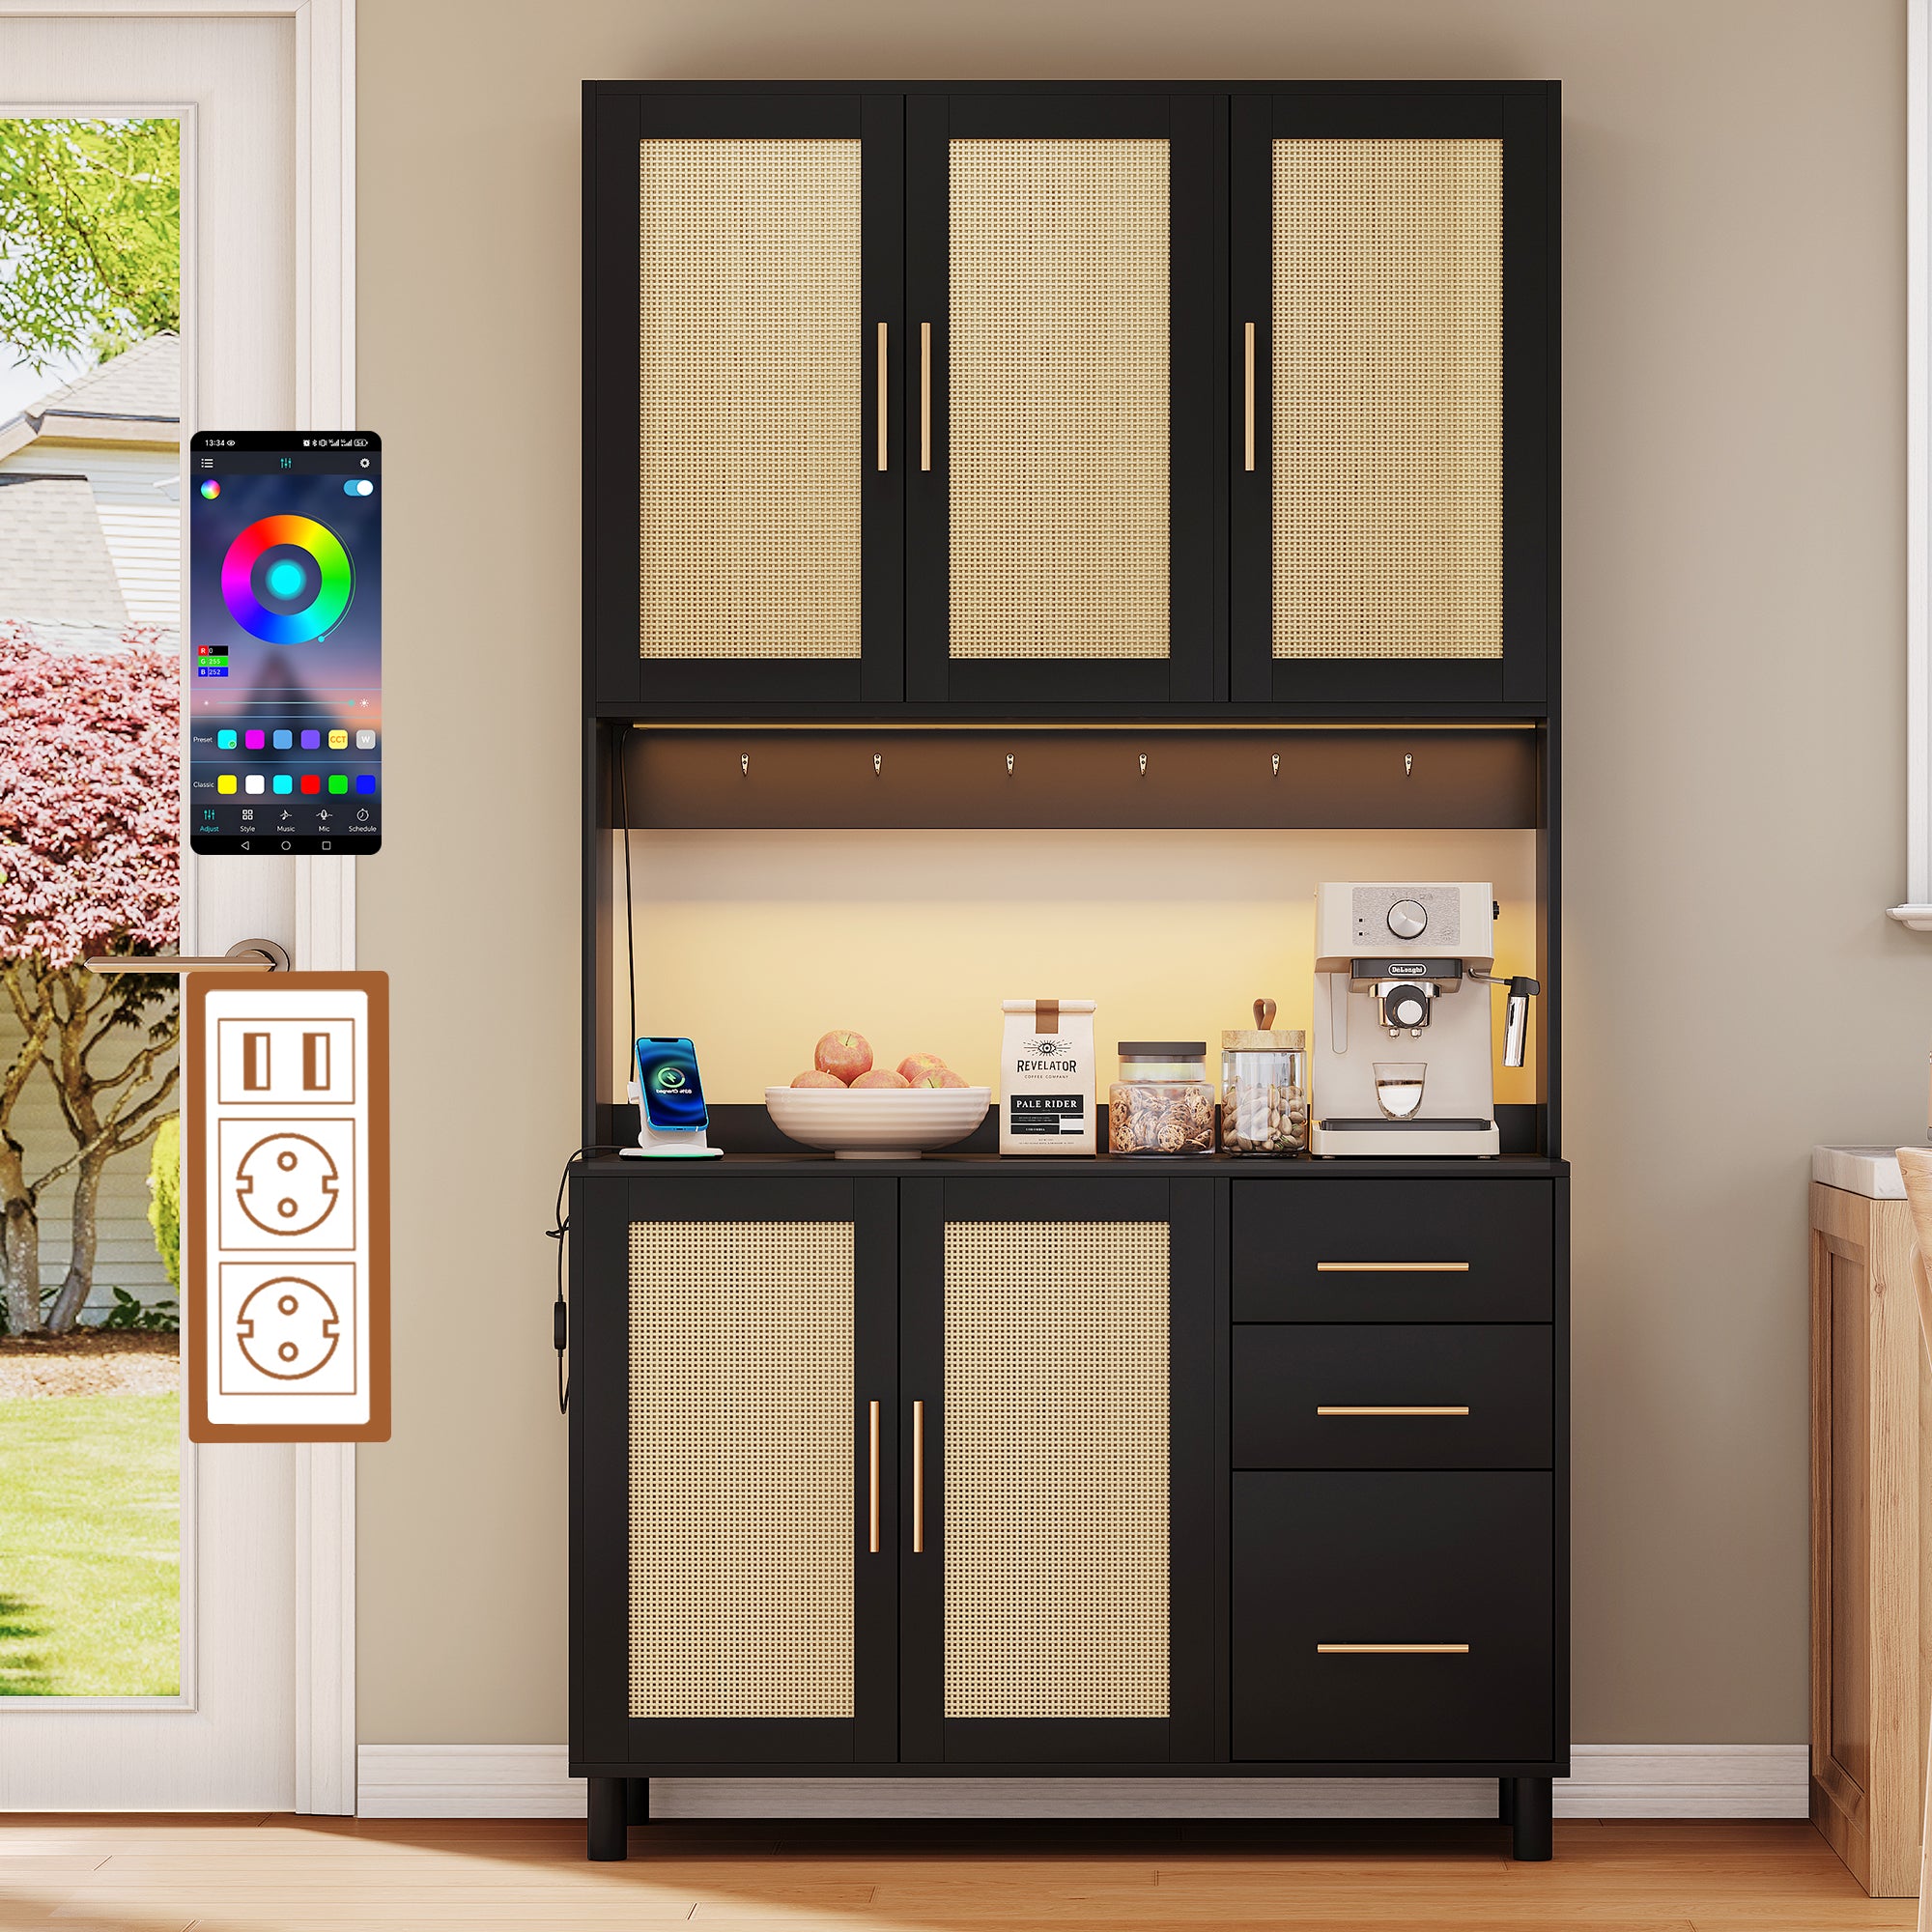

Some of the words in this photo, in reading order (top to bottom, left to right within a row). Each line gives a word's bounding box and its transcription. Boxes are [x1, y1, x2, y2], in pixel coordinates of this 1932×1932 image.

[199, 825, 219, 834] Adjust
[240, 825, 256, 834] Style
[1017, 1060, 1077, 1072] REVELATOR
